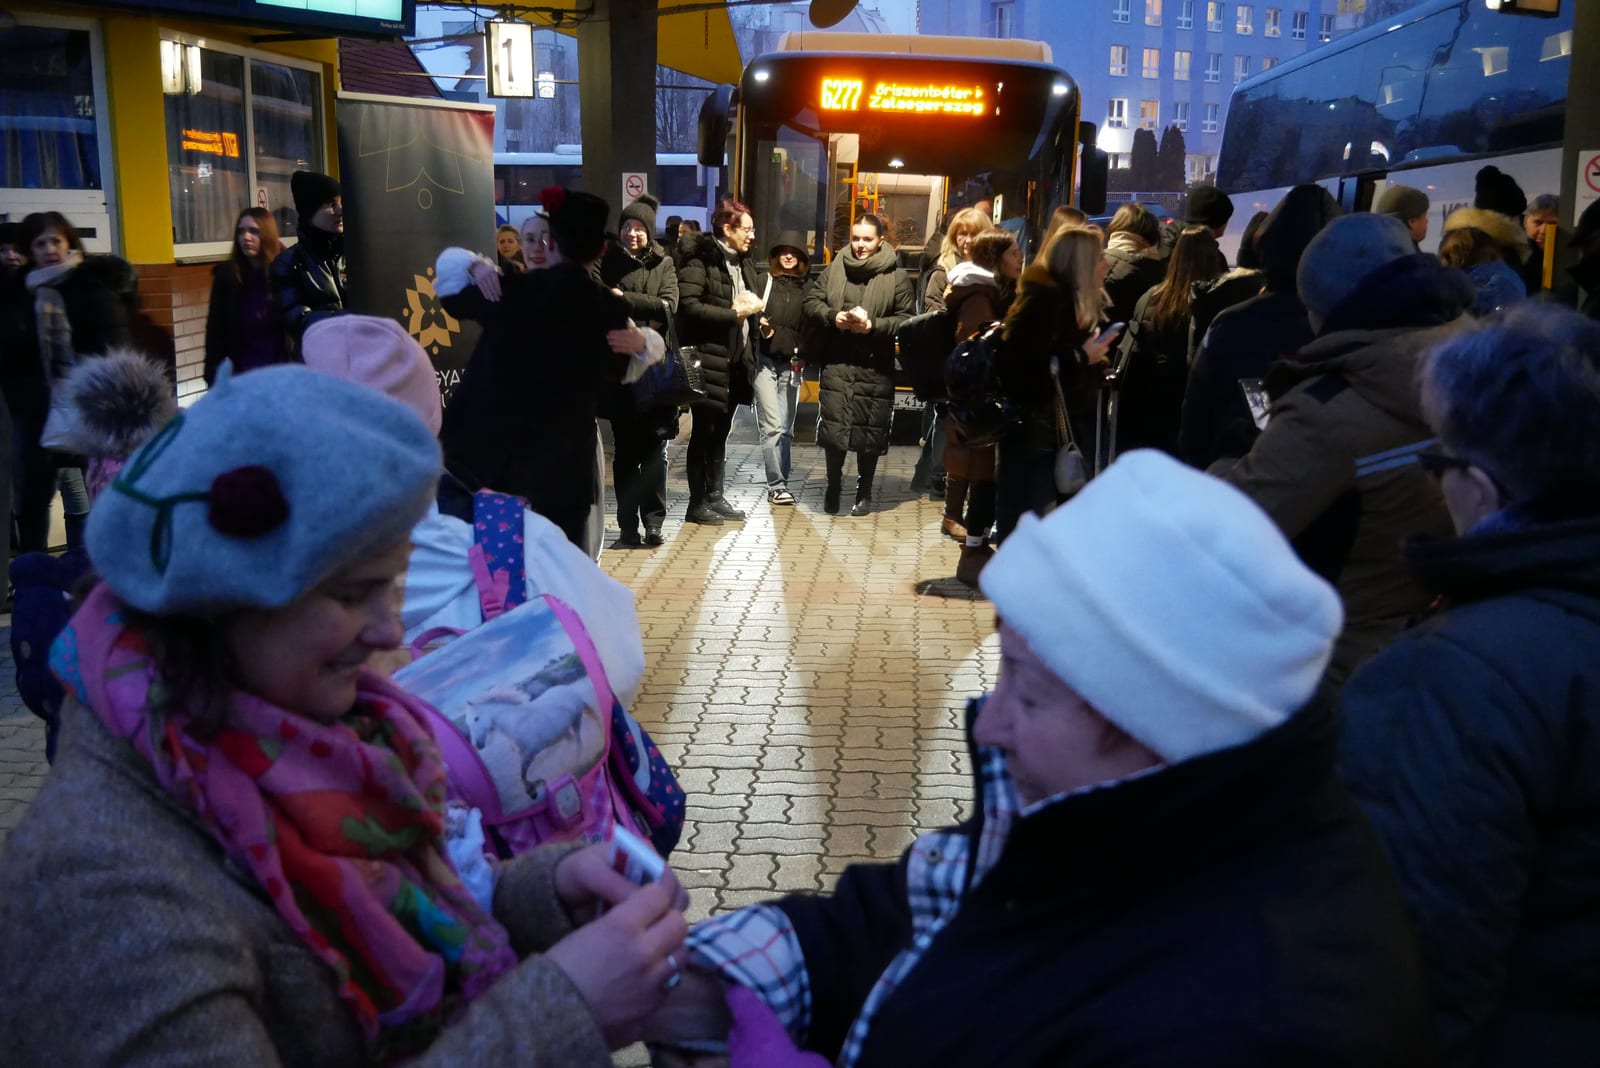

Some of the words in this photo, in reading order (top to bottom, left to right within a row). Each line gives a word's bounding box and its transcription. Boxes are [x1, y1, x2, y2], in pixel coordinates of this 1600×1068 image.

[502, 38, 515, 83] 1
[821, 78, 864, 111] 6277
[868, 95, 984, 116] Zalaegerszeg
